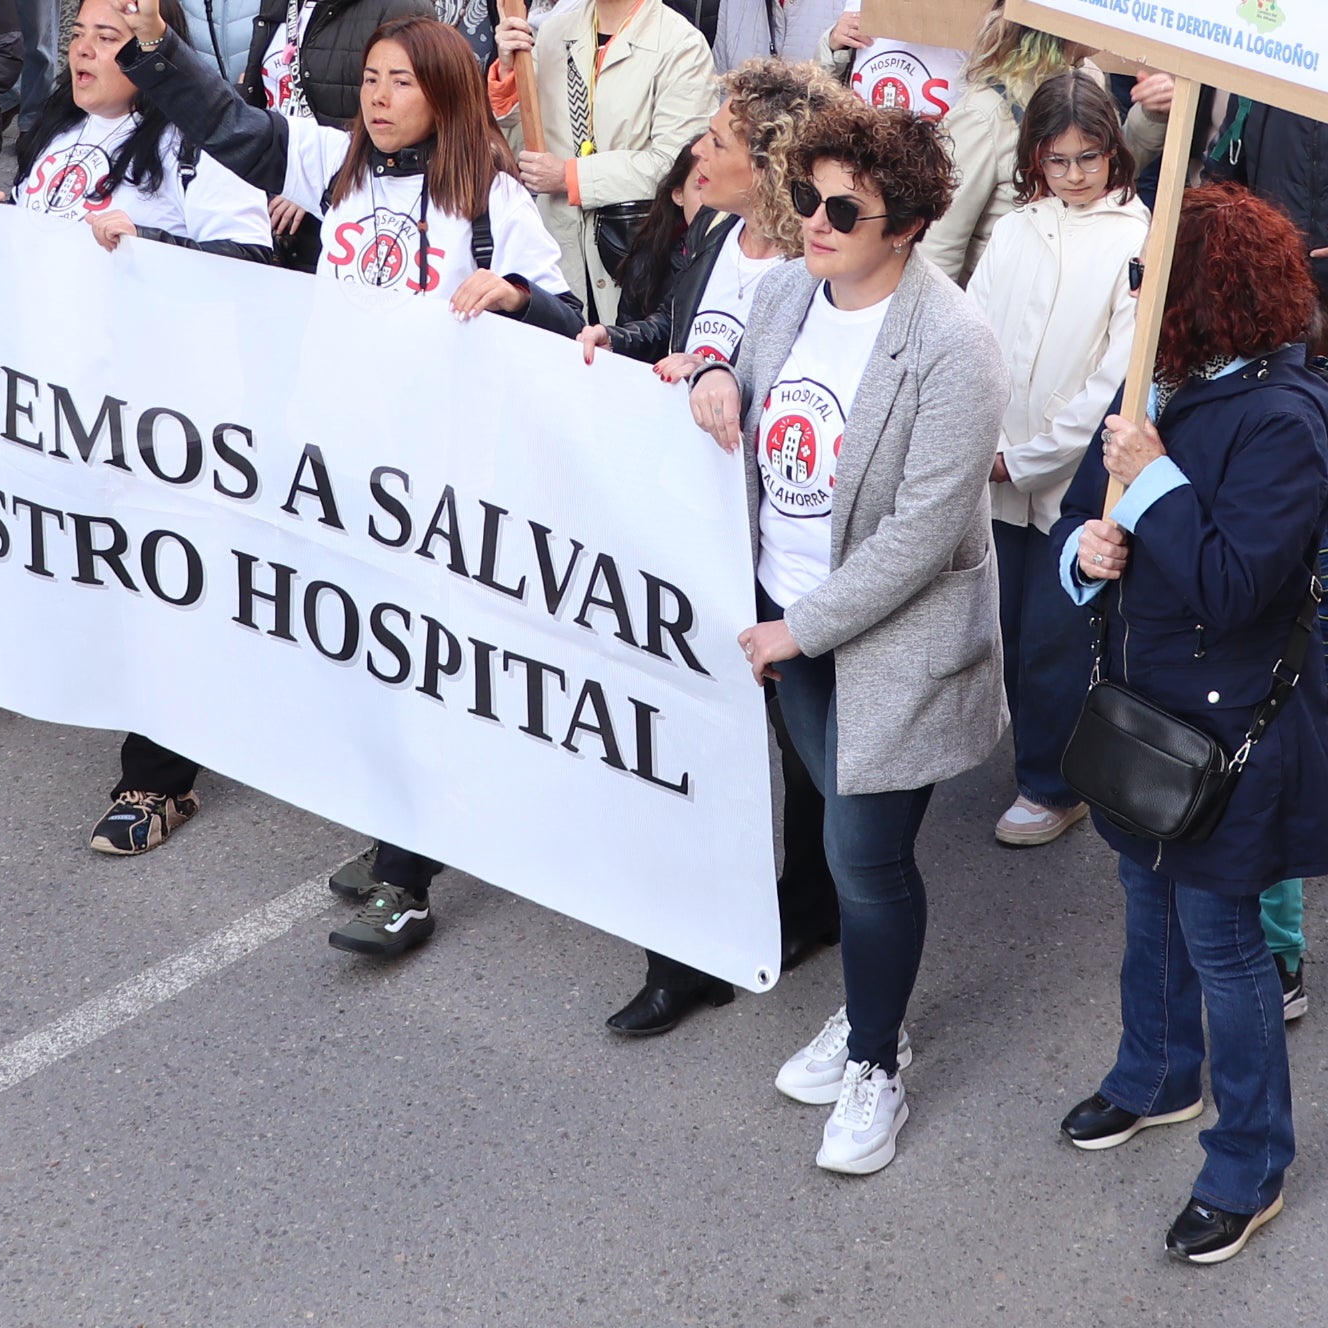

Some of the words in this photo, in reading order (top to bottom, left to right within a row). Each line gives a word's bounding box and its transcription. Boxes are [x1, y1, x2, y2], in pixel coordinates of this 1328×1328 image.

[869, 57, 916, 77] HOSPITAL
[1160, 5, 1175, 28] TE
[1175, 11, 1233, 50] DERIVEN
[1233, 27, 1245, 52] A
[1245, 31, 1320, 72] LOGROÑO!
[694, 320, 738, 349] HOSPITA
[280, 443, 349, 532] A
[368, 466, 713, 677] SALVAR
[231, 548, 690, 797] HOSPITAL
